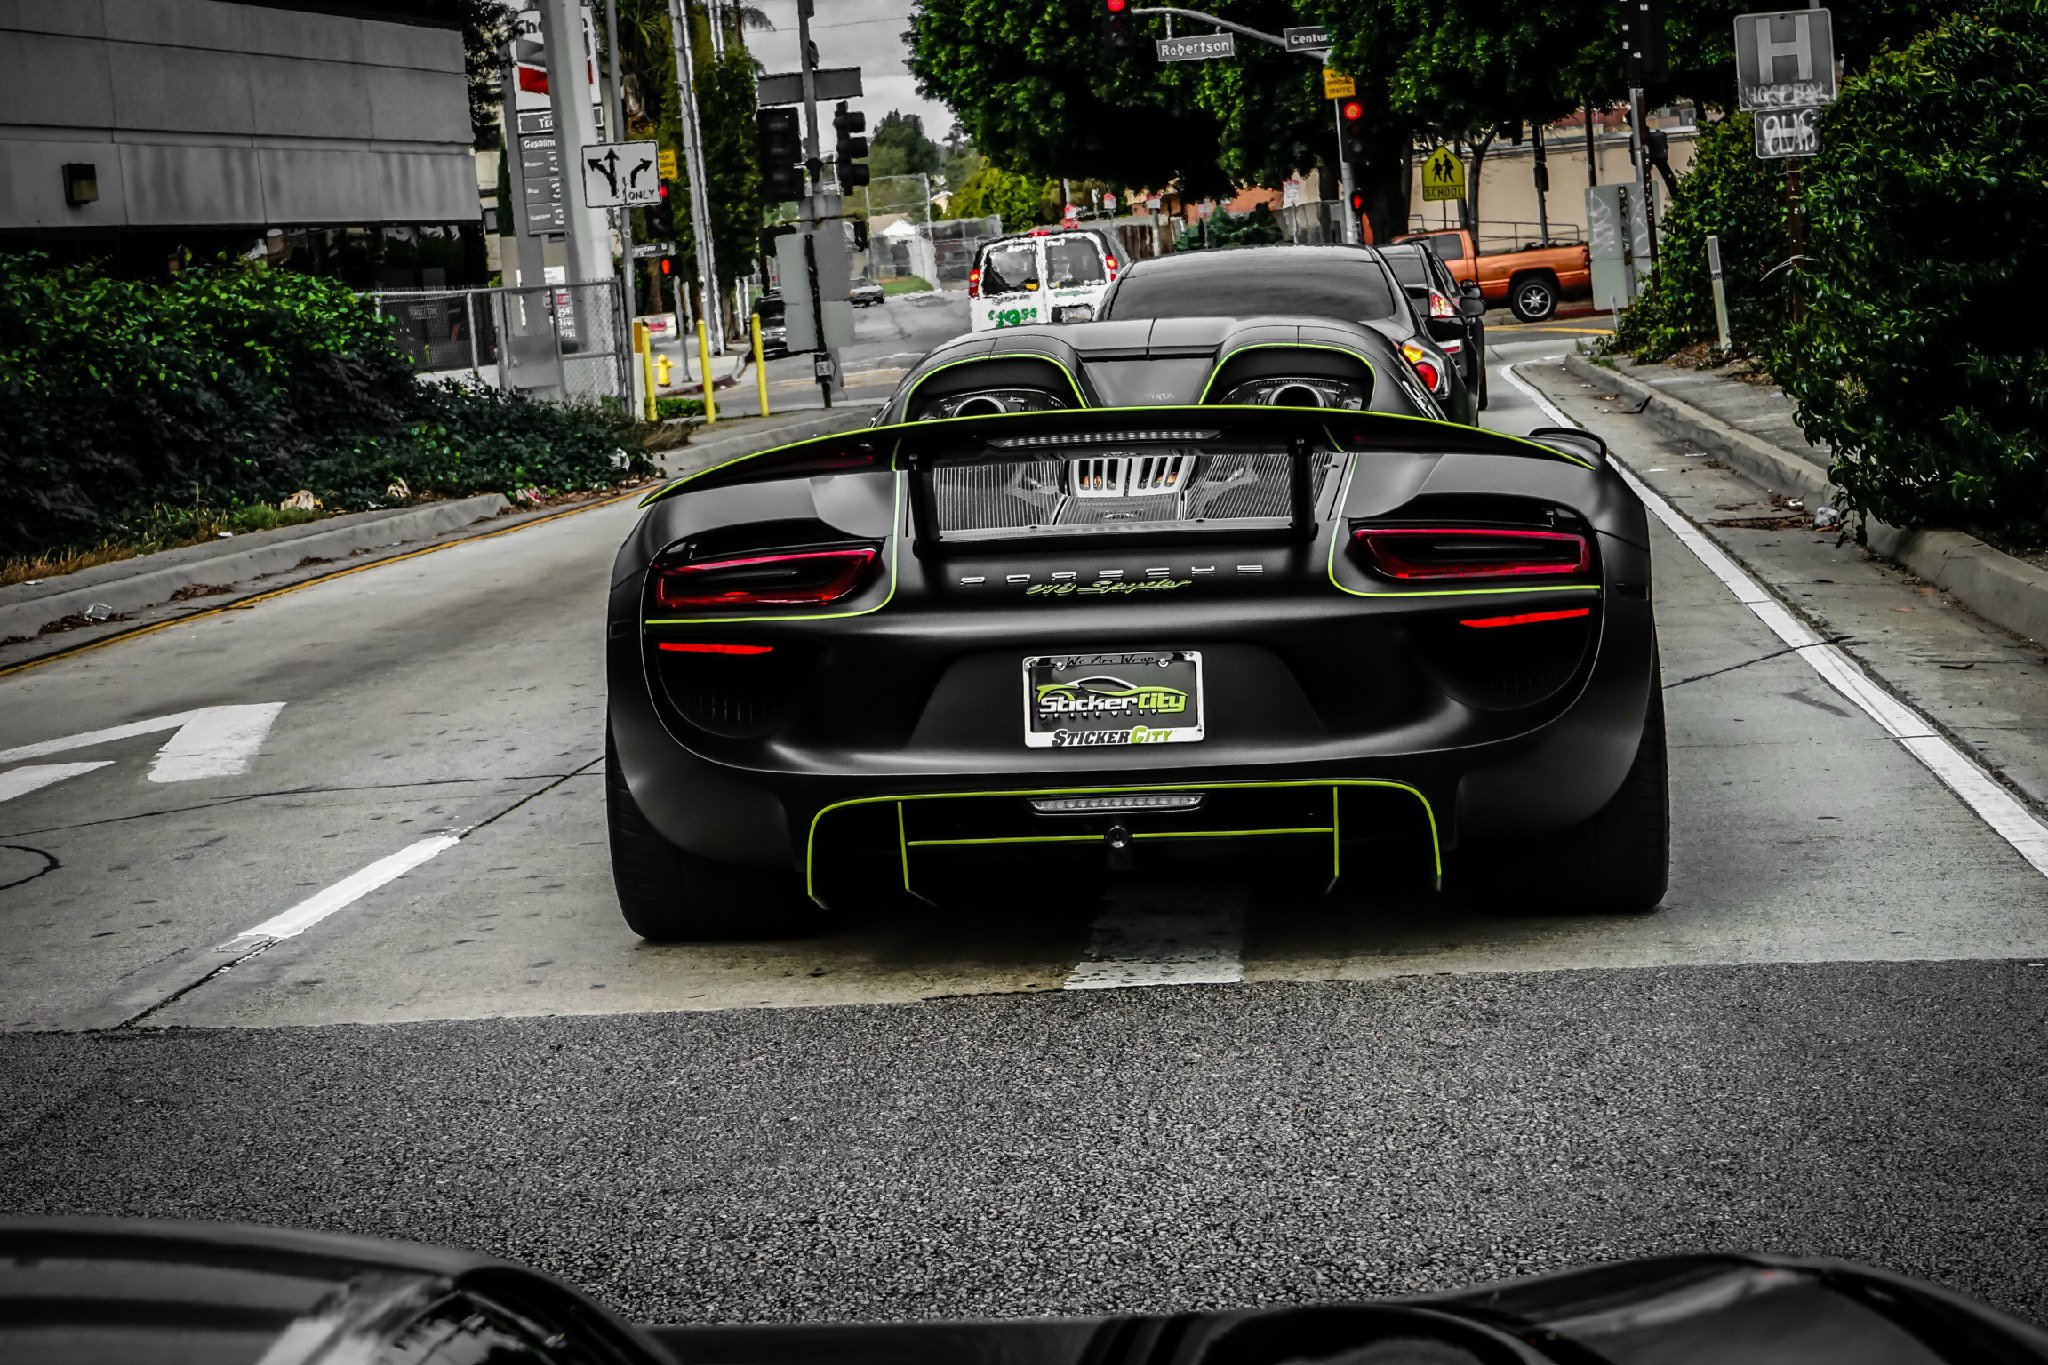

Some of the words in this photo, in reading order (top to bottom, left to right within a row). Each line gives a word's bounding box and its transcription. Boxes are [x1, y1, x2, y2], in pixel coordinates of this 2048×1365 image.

[1161, 41, 1230, 57] Robertson
[1755, 14, 1813, 84] H
[628, 189, 655, 201] ONLY
[1424, 187, 1463, 198] SCHOOL
[960, 564, 1263, 587] PORSCHE
[1066, 655, 1086, 666] We
